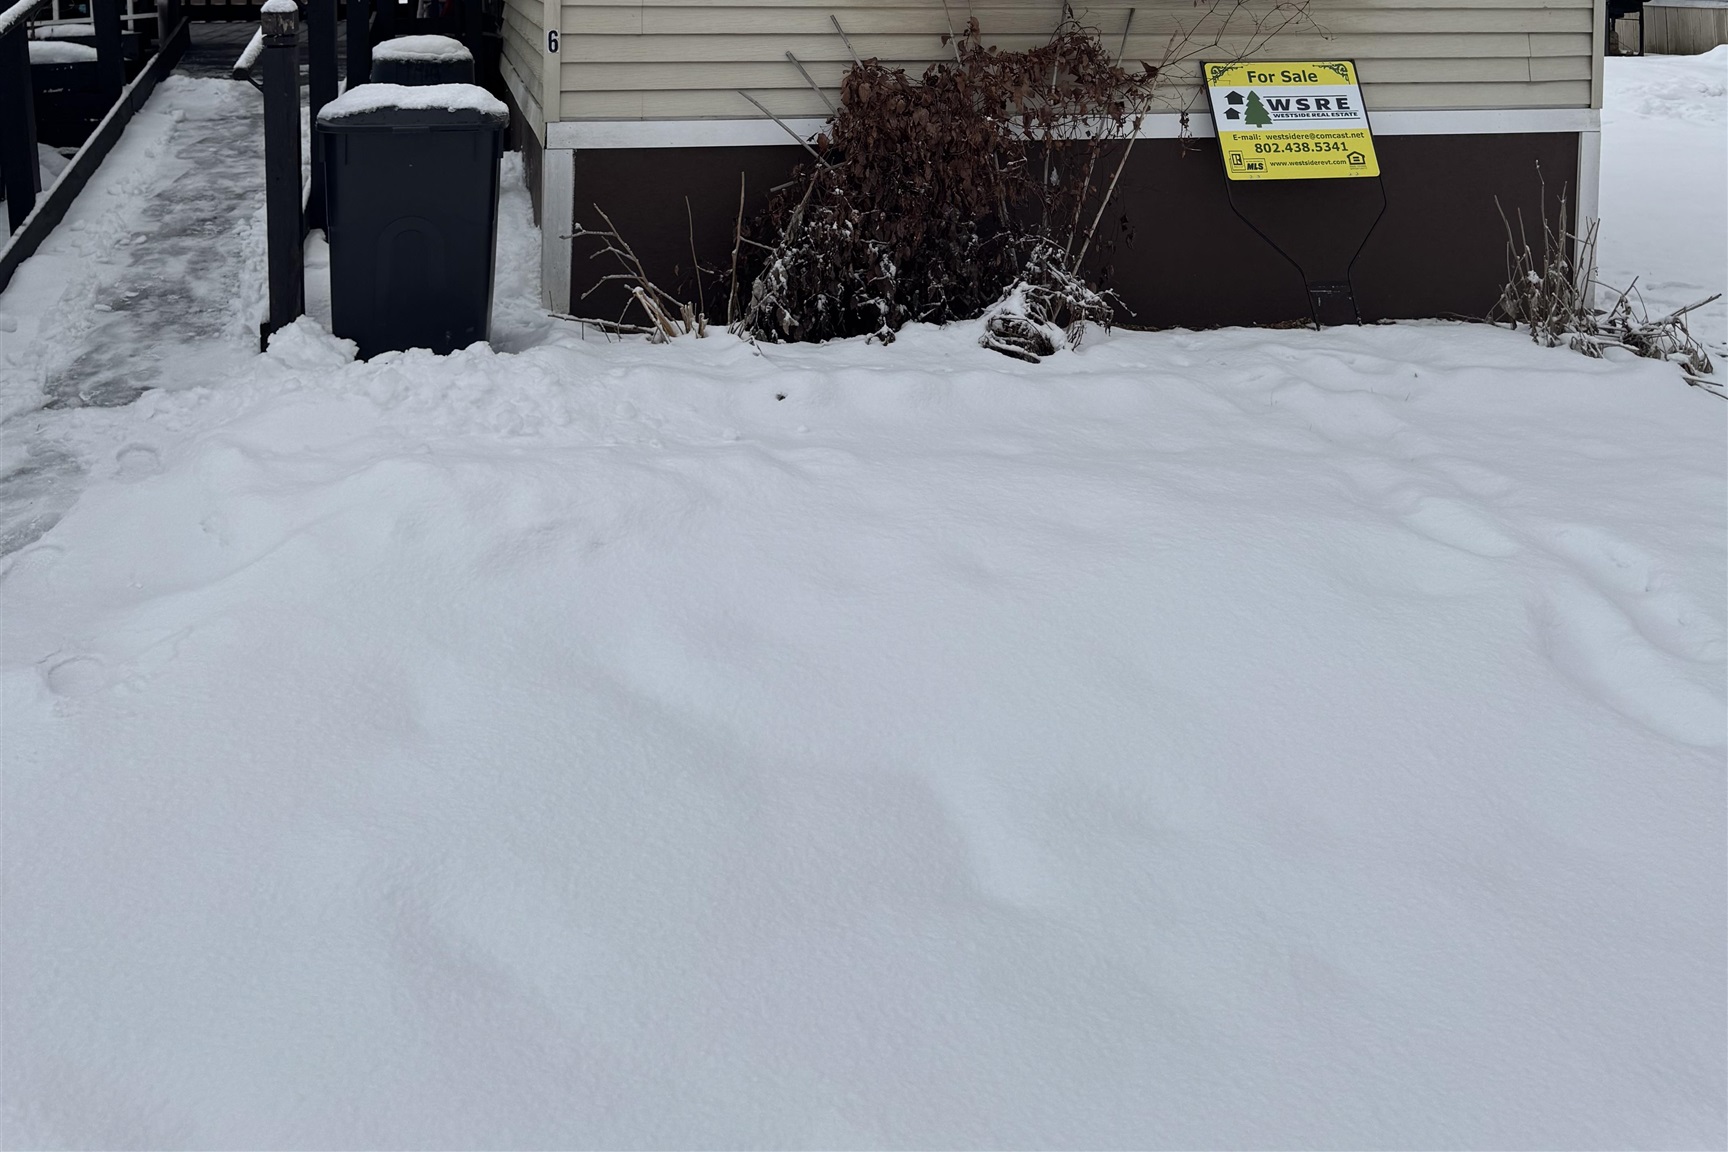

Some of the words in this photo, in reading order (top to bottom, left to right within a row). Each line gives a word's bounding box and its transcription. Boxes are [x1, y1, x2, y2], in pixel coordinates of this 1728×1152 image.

[547, 30, 559, 53] 6
[1247, 70, 1275, 83] For
[1281, 69, 1318, 83] Sale
[1266, 98, 1350, 111] WSRE
[1232, 133, 1261, 141] E-mail:
[1265, 132, 1365, 140] westsidere@comcast.net
[1254, 142, 1348, 153] 802.438.5341
[1269, 159, 1347, 167] www.westsiderevt.com
